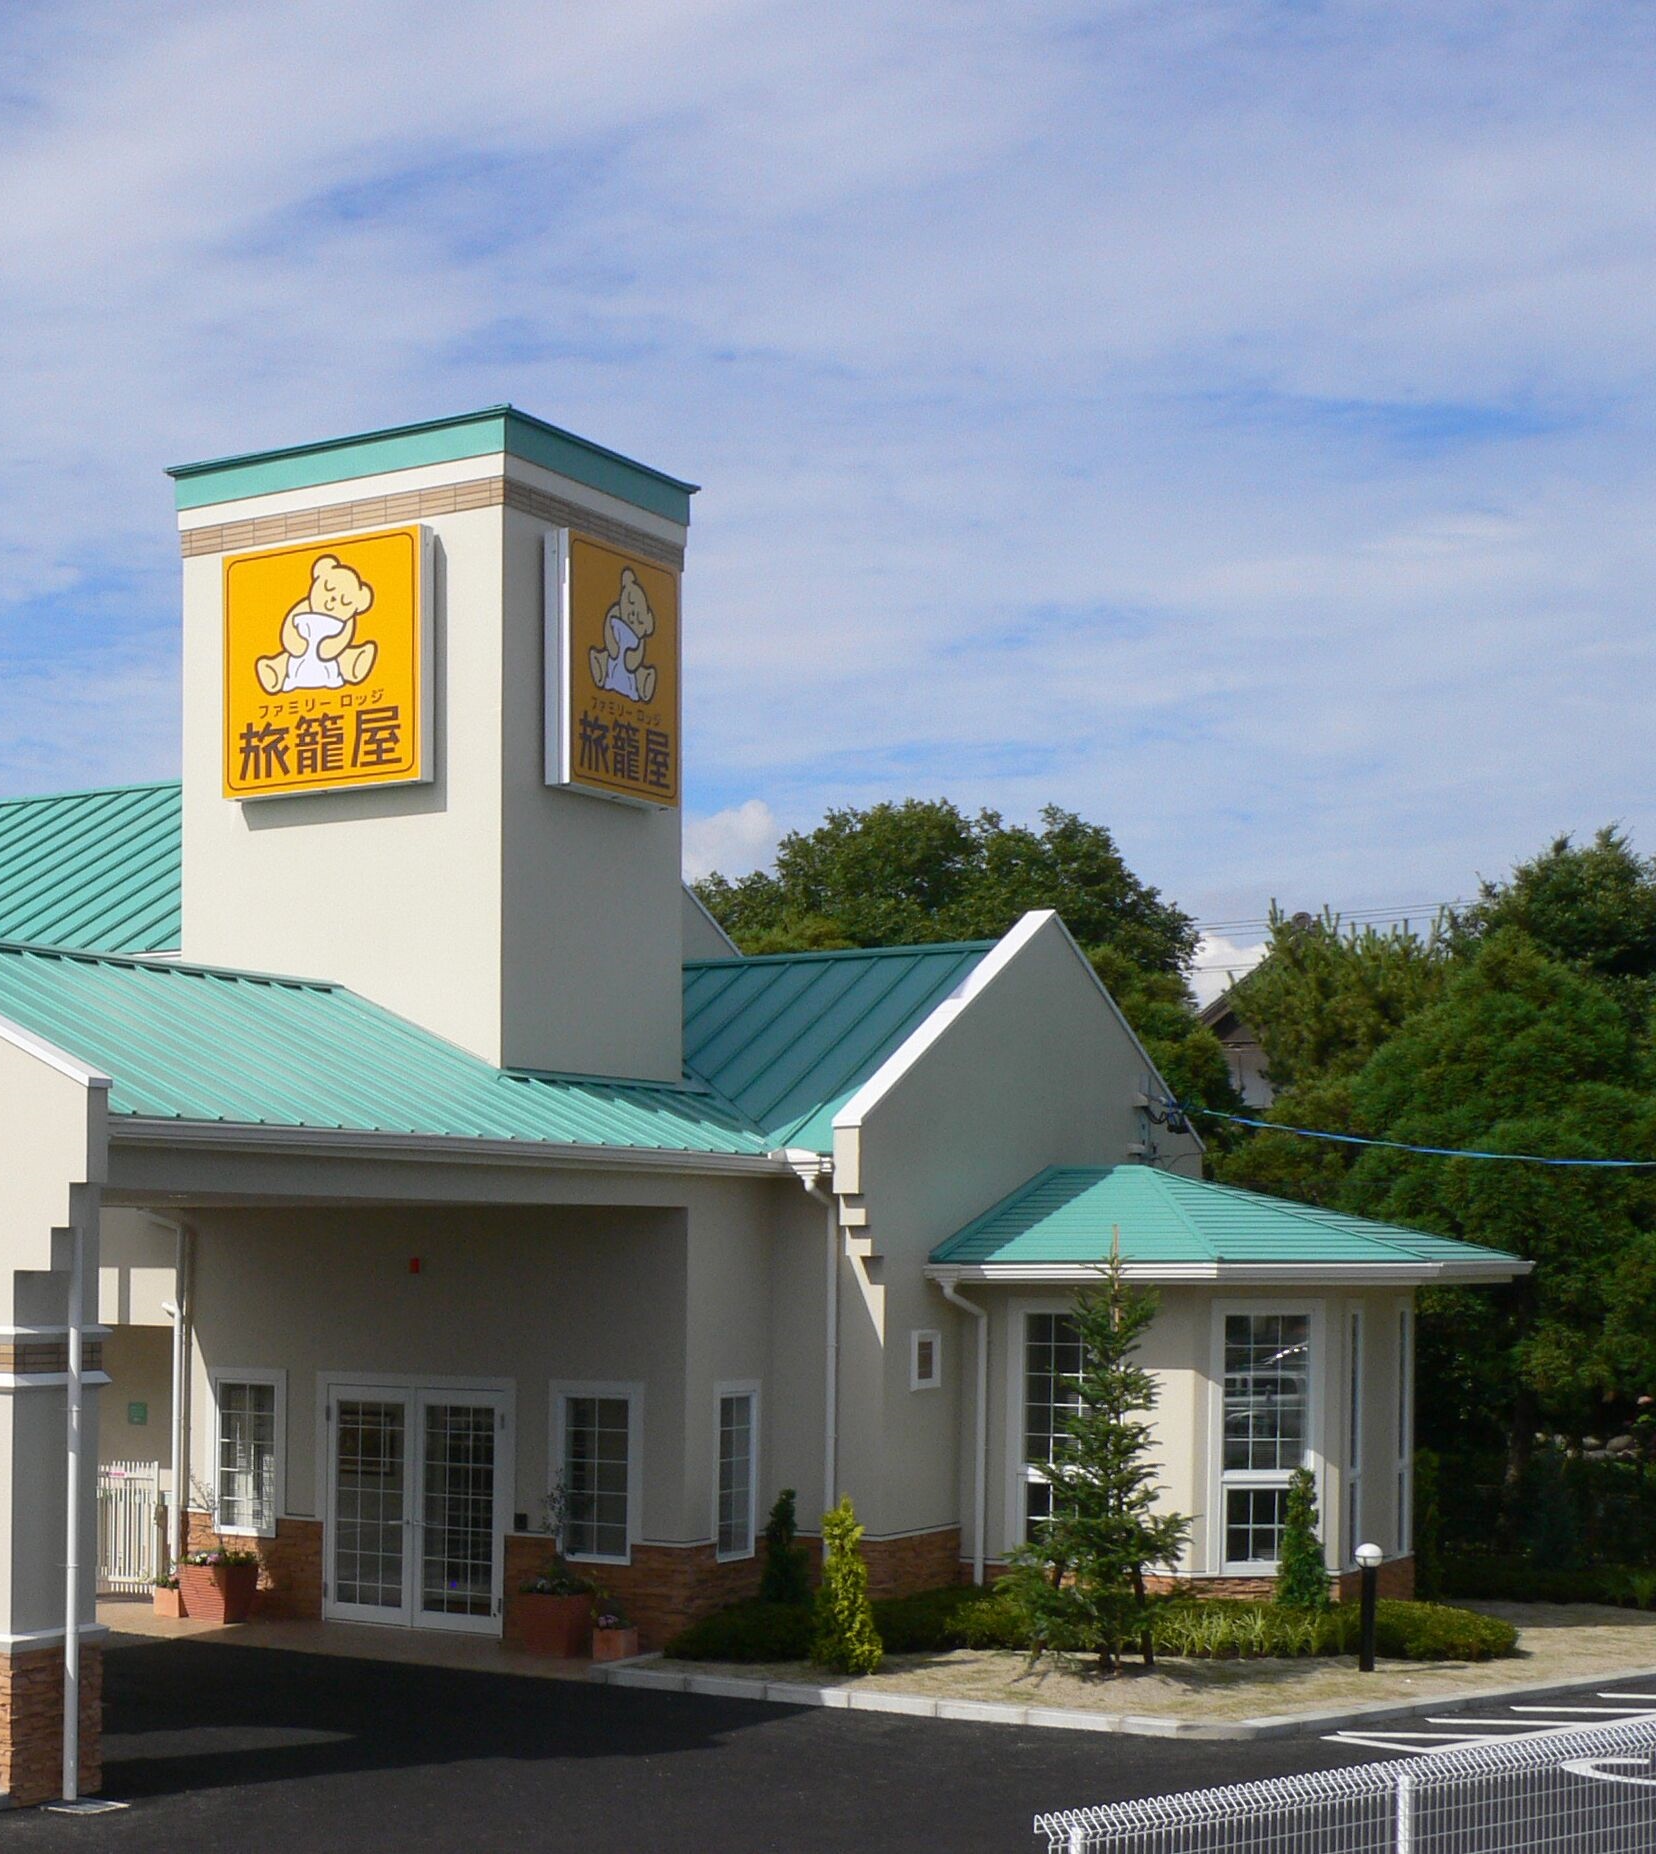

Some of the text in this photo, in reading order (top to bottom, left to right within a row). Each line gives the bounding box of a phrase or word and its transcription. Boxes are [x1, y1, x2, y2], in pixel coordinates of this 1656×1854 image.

[258, 688, 385, 719] ファミリー ロッジ
[591, 696, 633, 717] ファミリー
[239, 705, 403, 781] 旅籠屋
[579, 710, 671, 790] 旅籠屋
